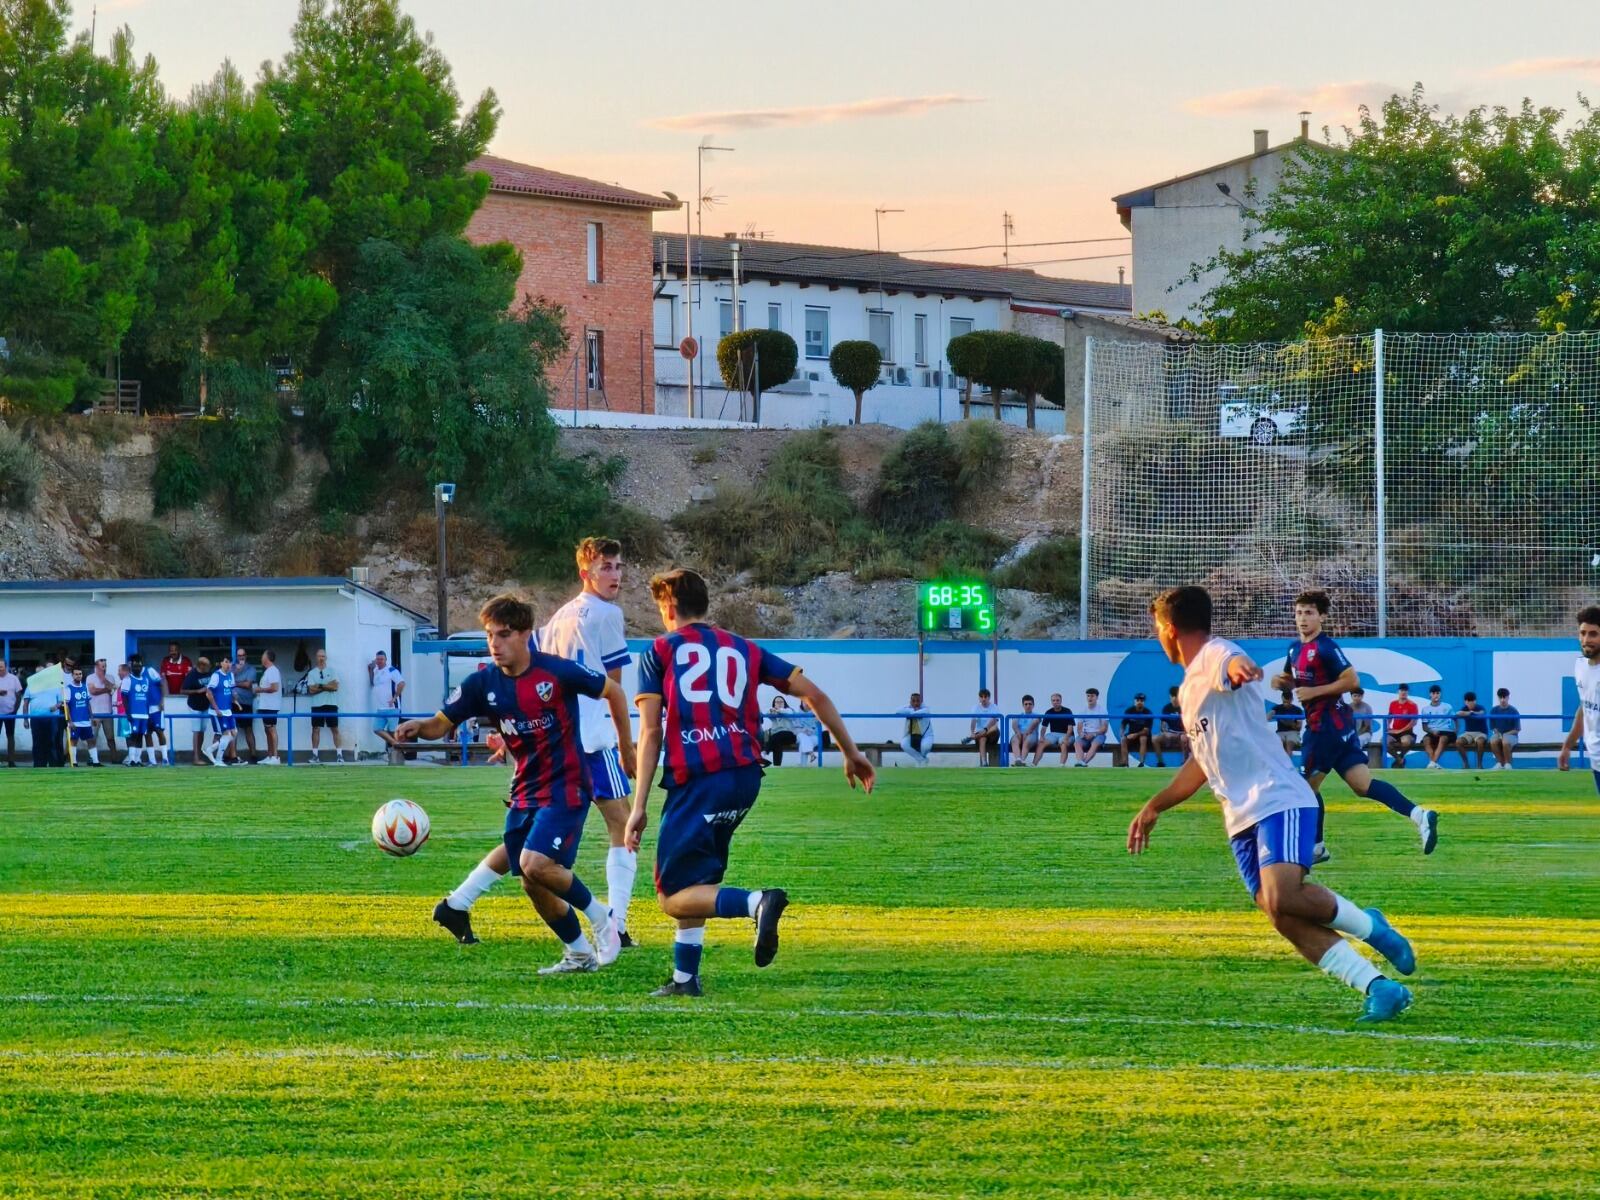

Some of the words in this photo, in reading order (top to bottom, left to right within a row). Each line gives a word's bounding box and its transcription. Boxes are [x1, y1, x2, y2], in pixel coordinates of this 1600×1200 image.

[928, 585, 983, 606] 68:35
[978, 609, 991, 630] 5
[675, 642, 748, 709] 20
